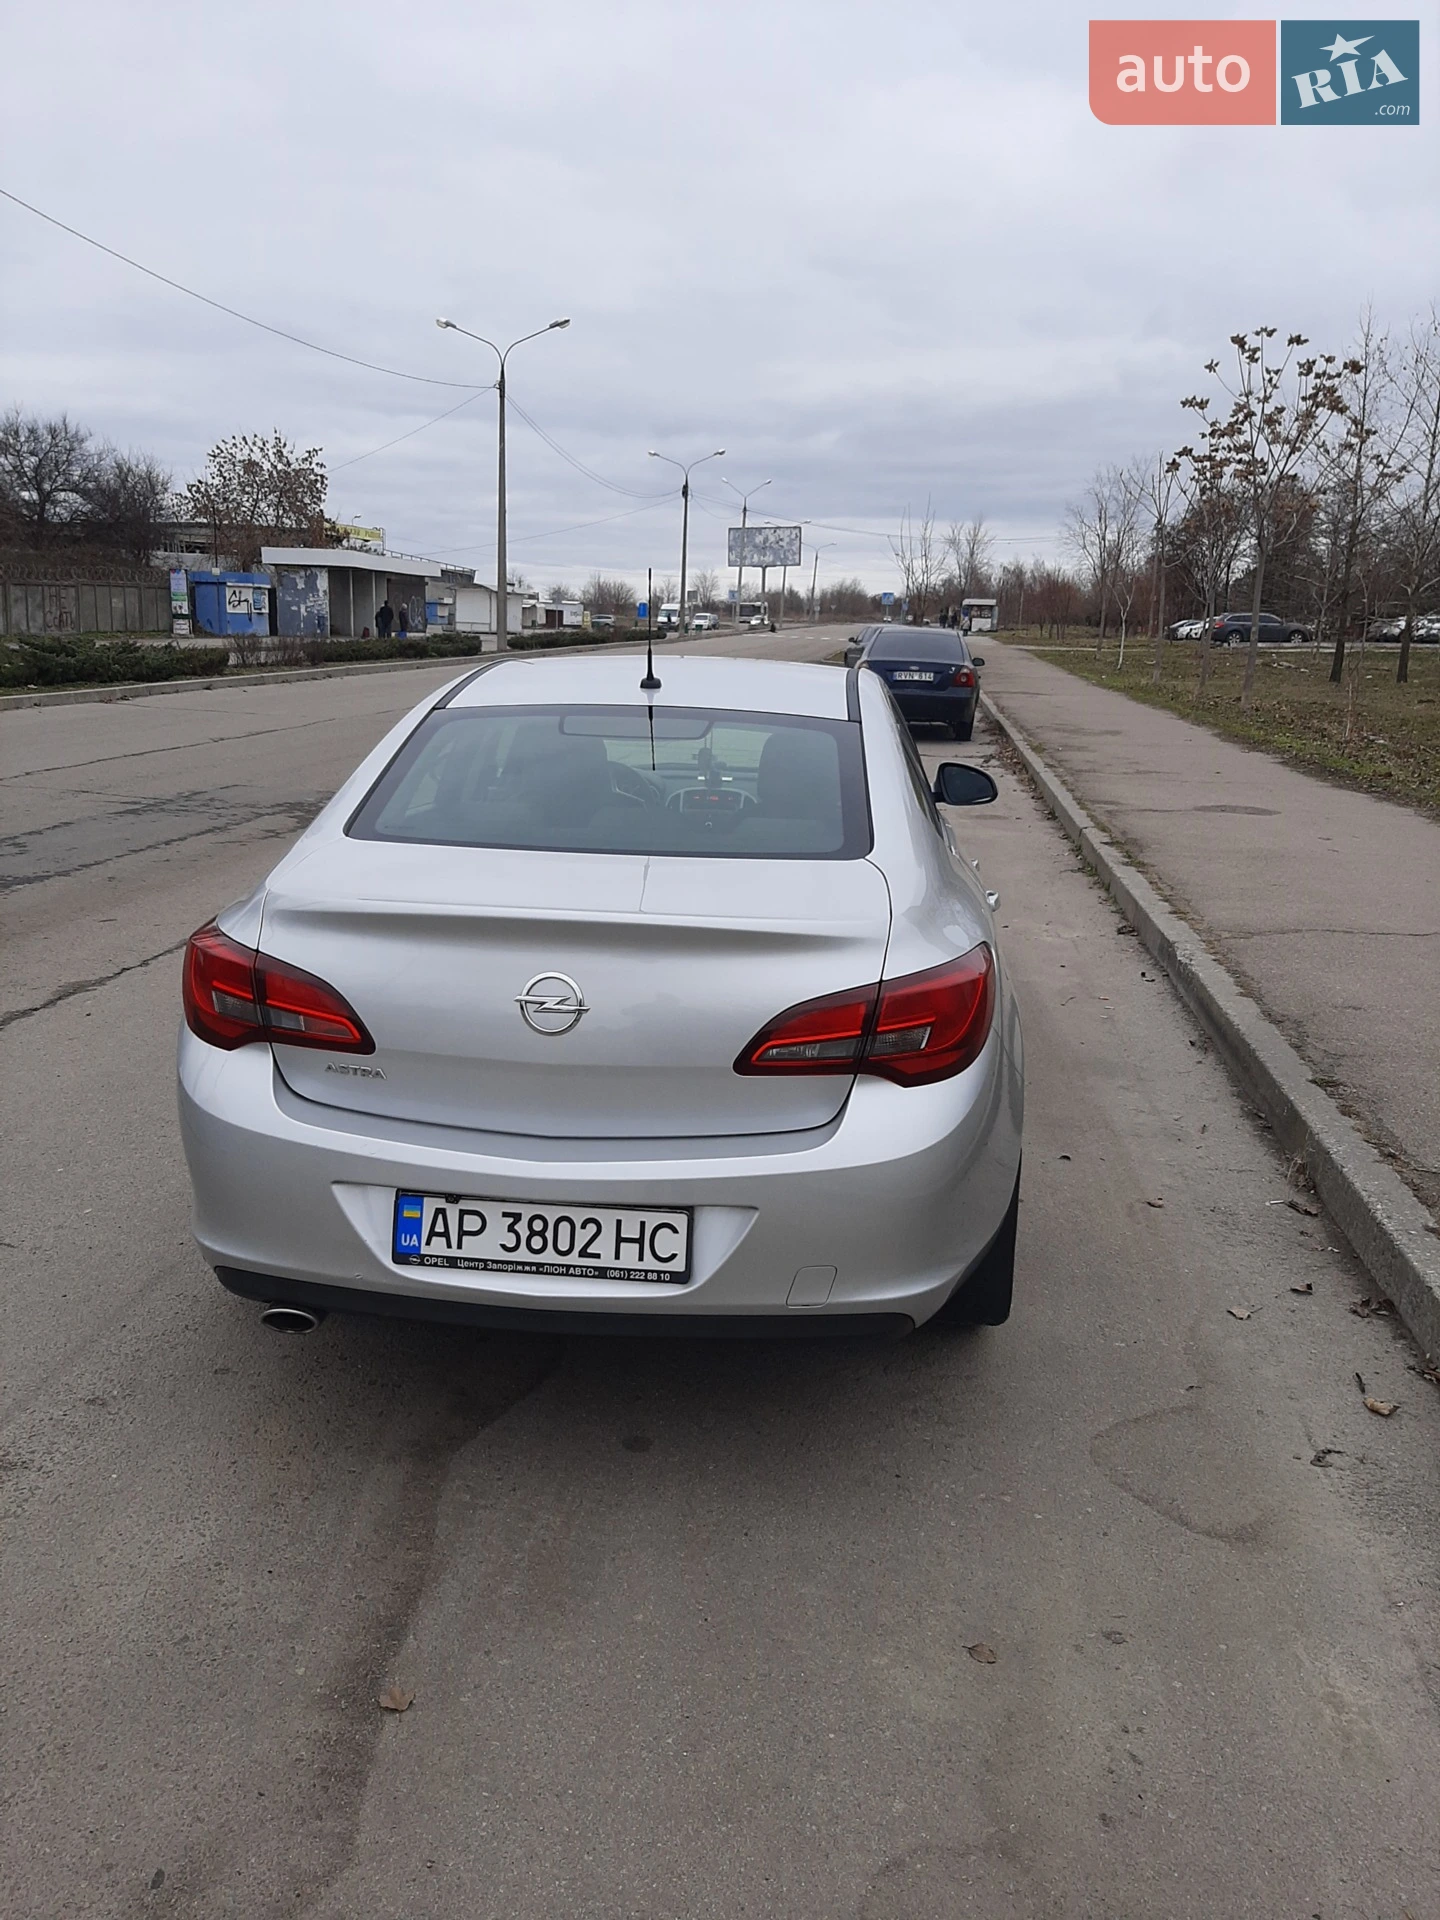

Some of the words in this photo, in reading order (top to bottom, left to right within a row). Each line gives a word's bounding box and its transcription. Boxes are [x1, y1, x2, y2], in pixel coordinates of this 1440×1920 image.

[897, 672, 915, 680] RVN
[324, 1062, 388, 1080] ASTRA
[401, 1232, 420, 1248] UA
[425, 1207, 488, 1250] AP
[499, 1211, 602, 1260] 3802
[614, 1218, 680, 1264] HC
[424, 1256, 450, 1266] OPEL
[457, 1259, 485, 1269] Центр
[486, 1262, 537, 1272] Запоріжжя
[606, 1269, 628, 1279] (061)
[629, 1271, 646, 1280] 222
[647, 1272, 658, 1280] 88
[660, 1273, 671, 1281] 10
